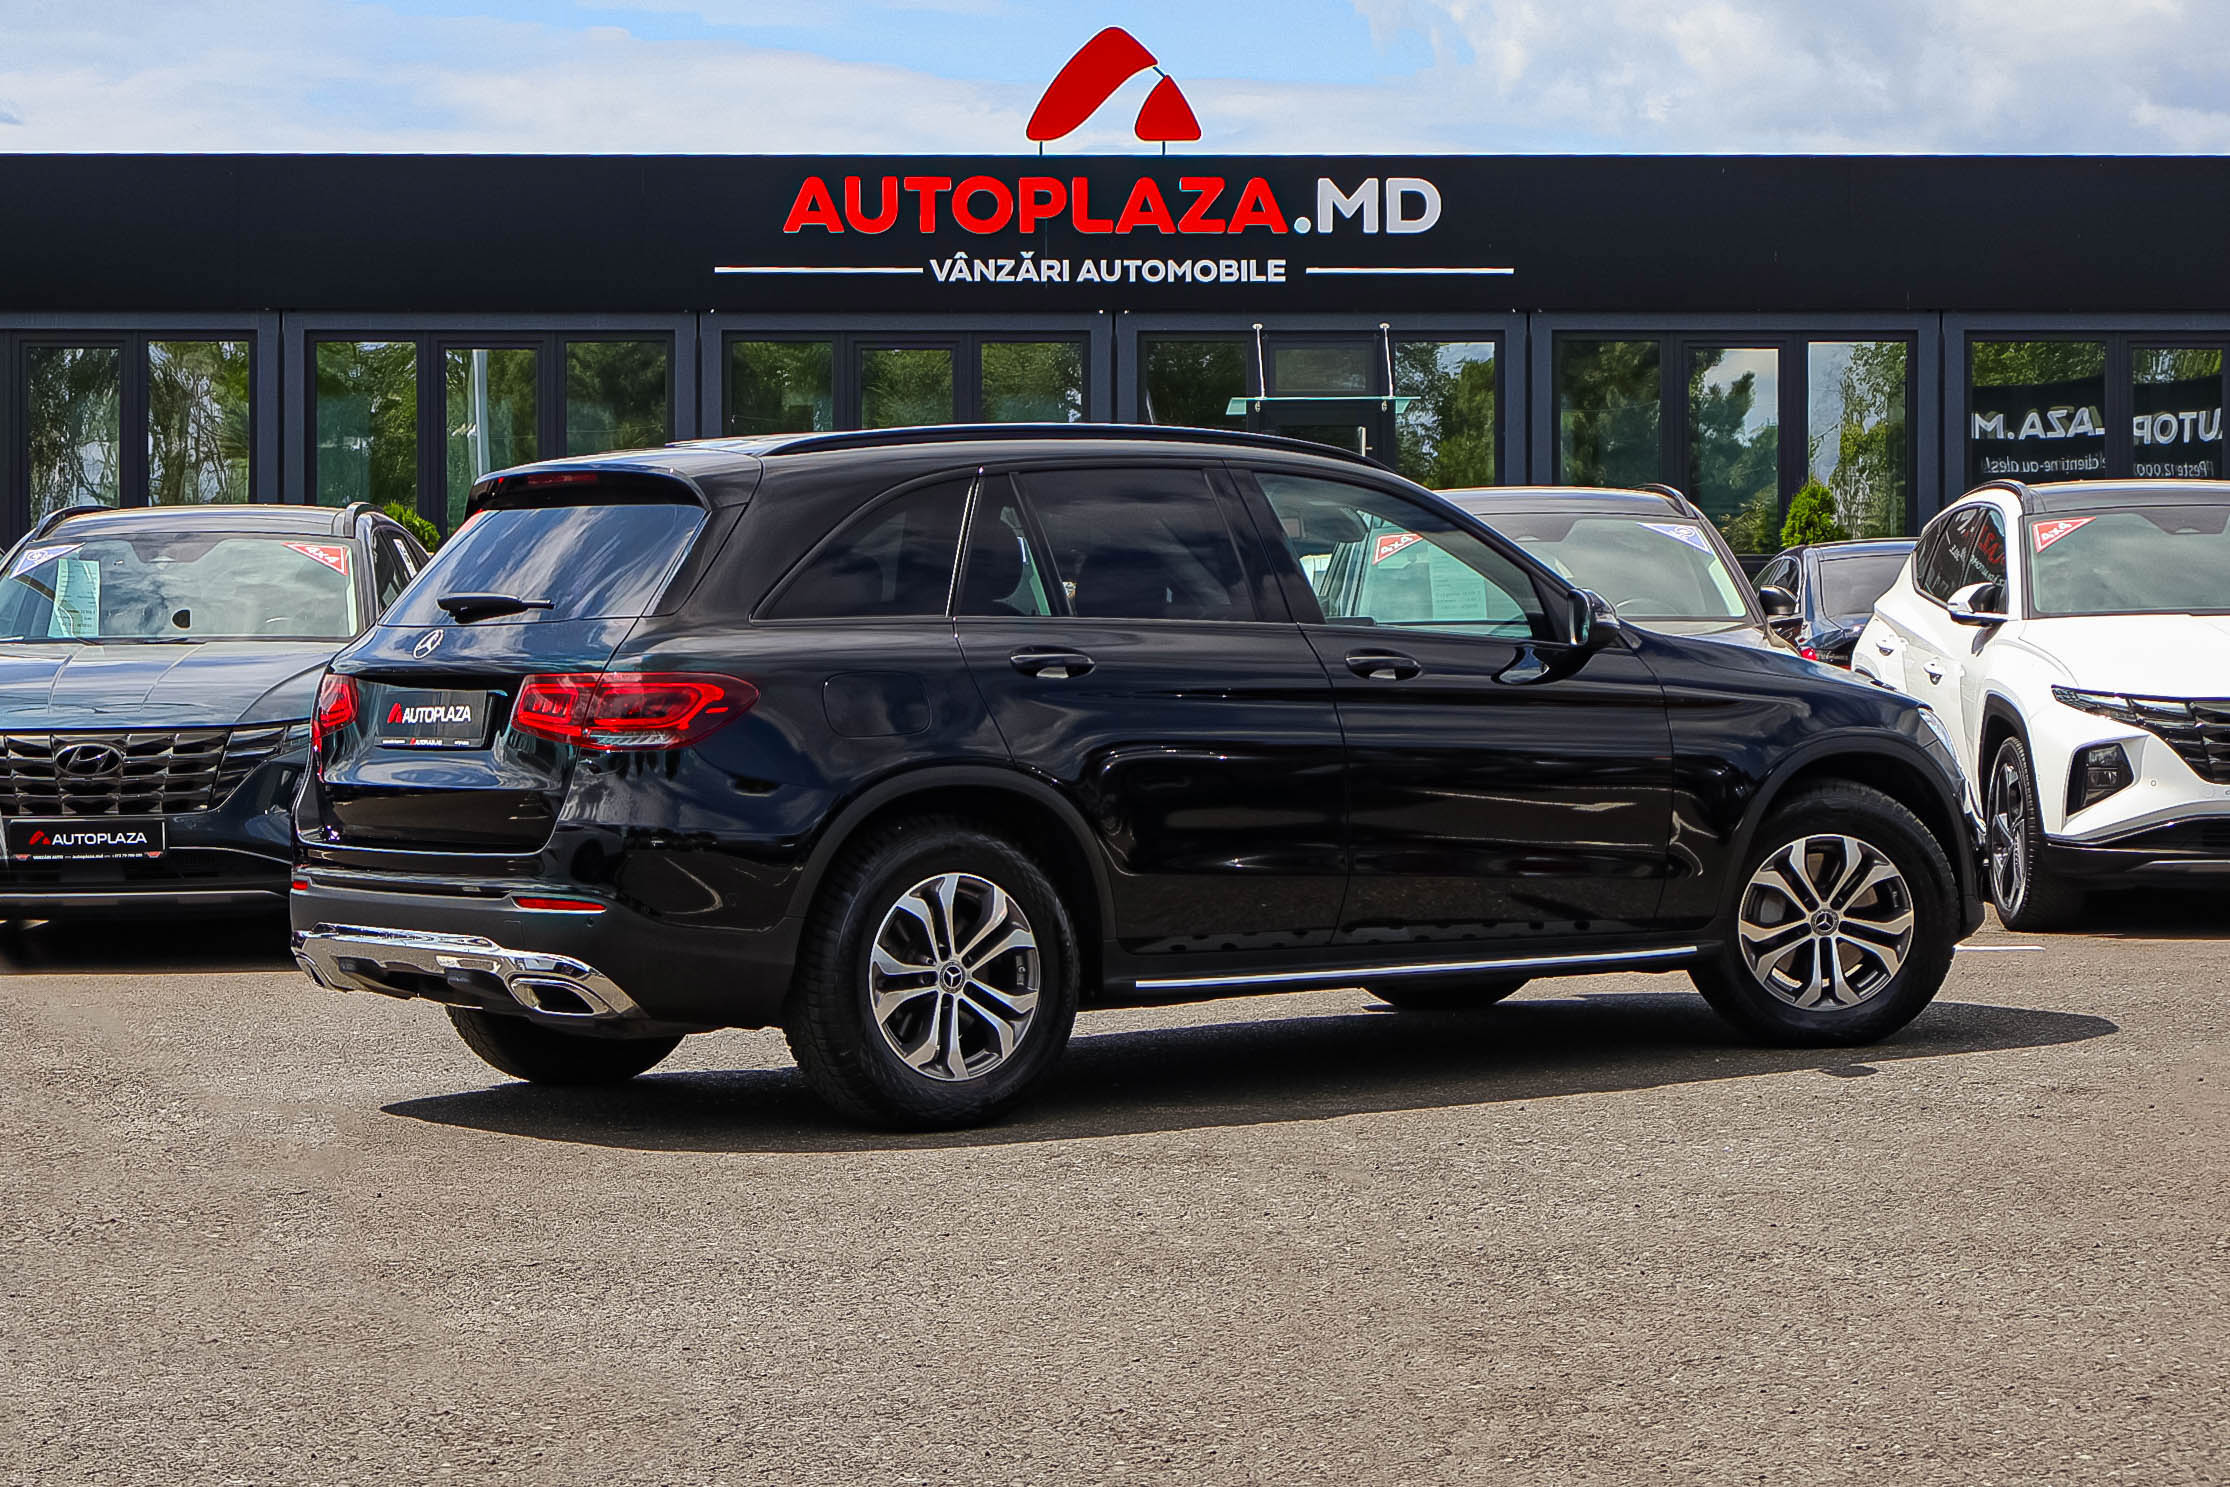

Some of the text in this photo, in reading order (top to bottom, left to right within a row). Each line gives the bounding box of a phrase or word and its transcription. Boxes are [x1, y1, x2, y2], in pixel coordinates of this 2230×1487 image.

[783, 175, 1442, 235] AUTOPLAZA.MD
[929, 251, 1287, 283] VÂNZĂRI AUTOMOBILE
[402, 705, 472, 724] AUTOPLAZA
[52, 832, 148, 846] AUTOPLAZA
